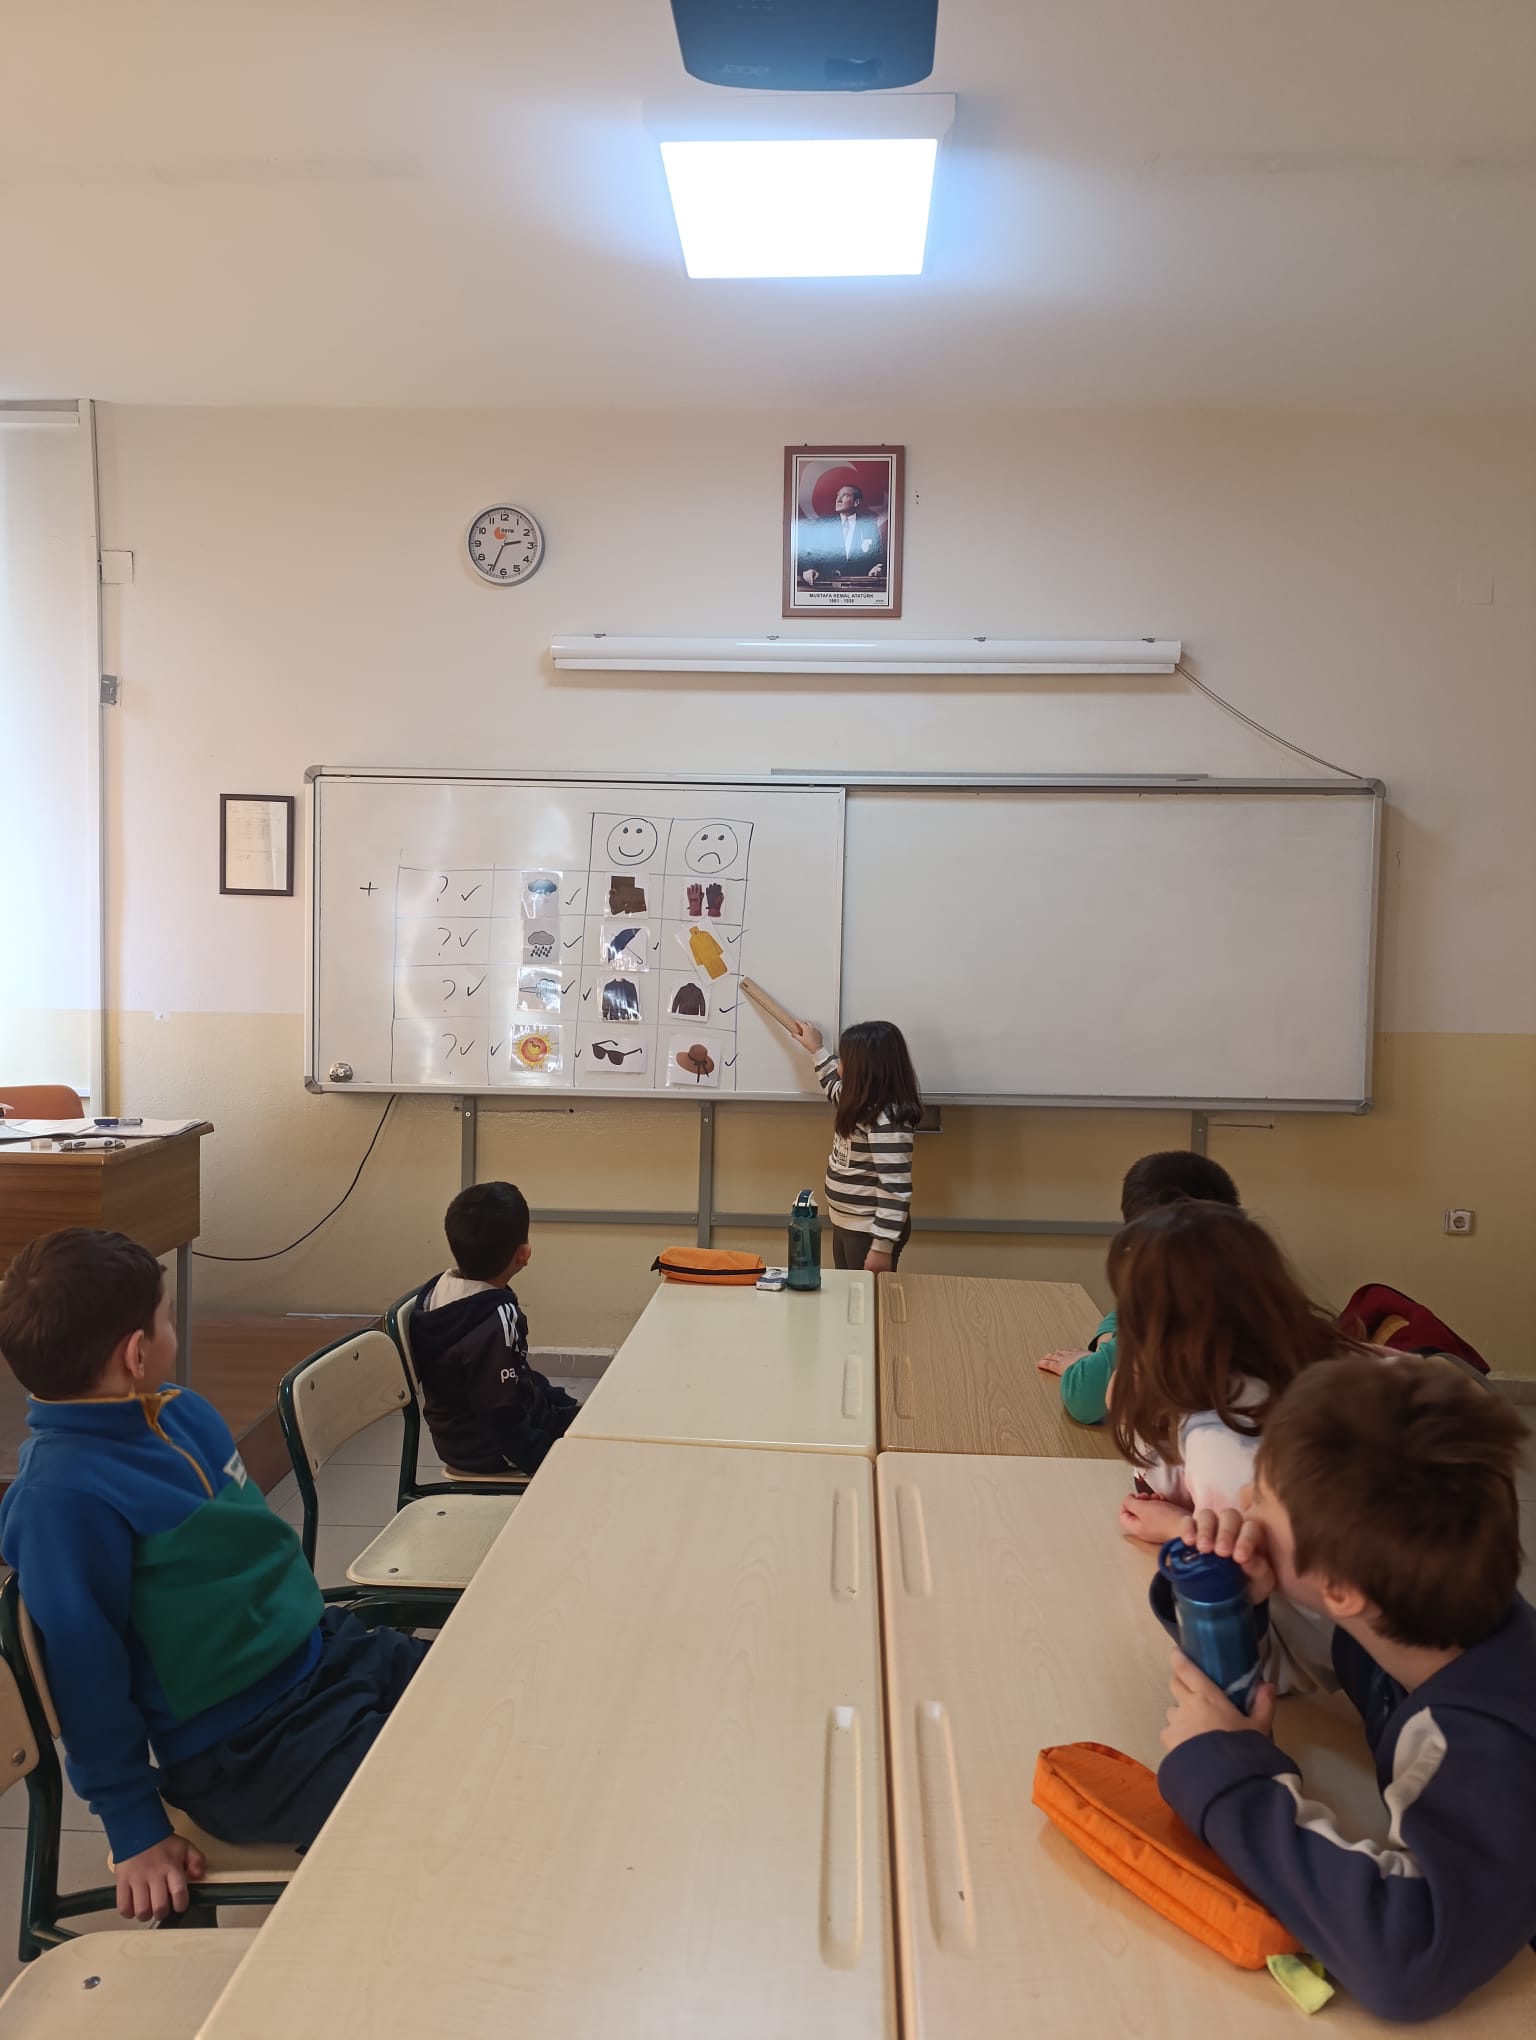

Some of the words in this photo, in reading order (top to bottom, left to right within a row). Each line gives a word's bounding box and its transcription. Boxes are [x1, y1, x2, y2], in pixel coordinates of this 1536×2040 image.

[489, 517, 495, 525] 11
[500, 513, 510, 521] 12
[526, 542, 534, 550] 3
[478, 553, 485, 561] 8
[523, 555, 530, 563] 4
[500, 568, 507, 576] 6
[513, 564, 521, 572] 5
[436, 875, 448, 902] ?
[437, 927, 451, 956] ?
[442, 979, 456, 1013] ?
